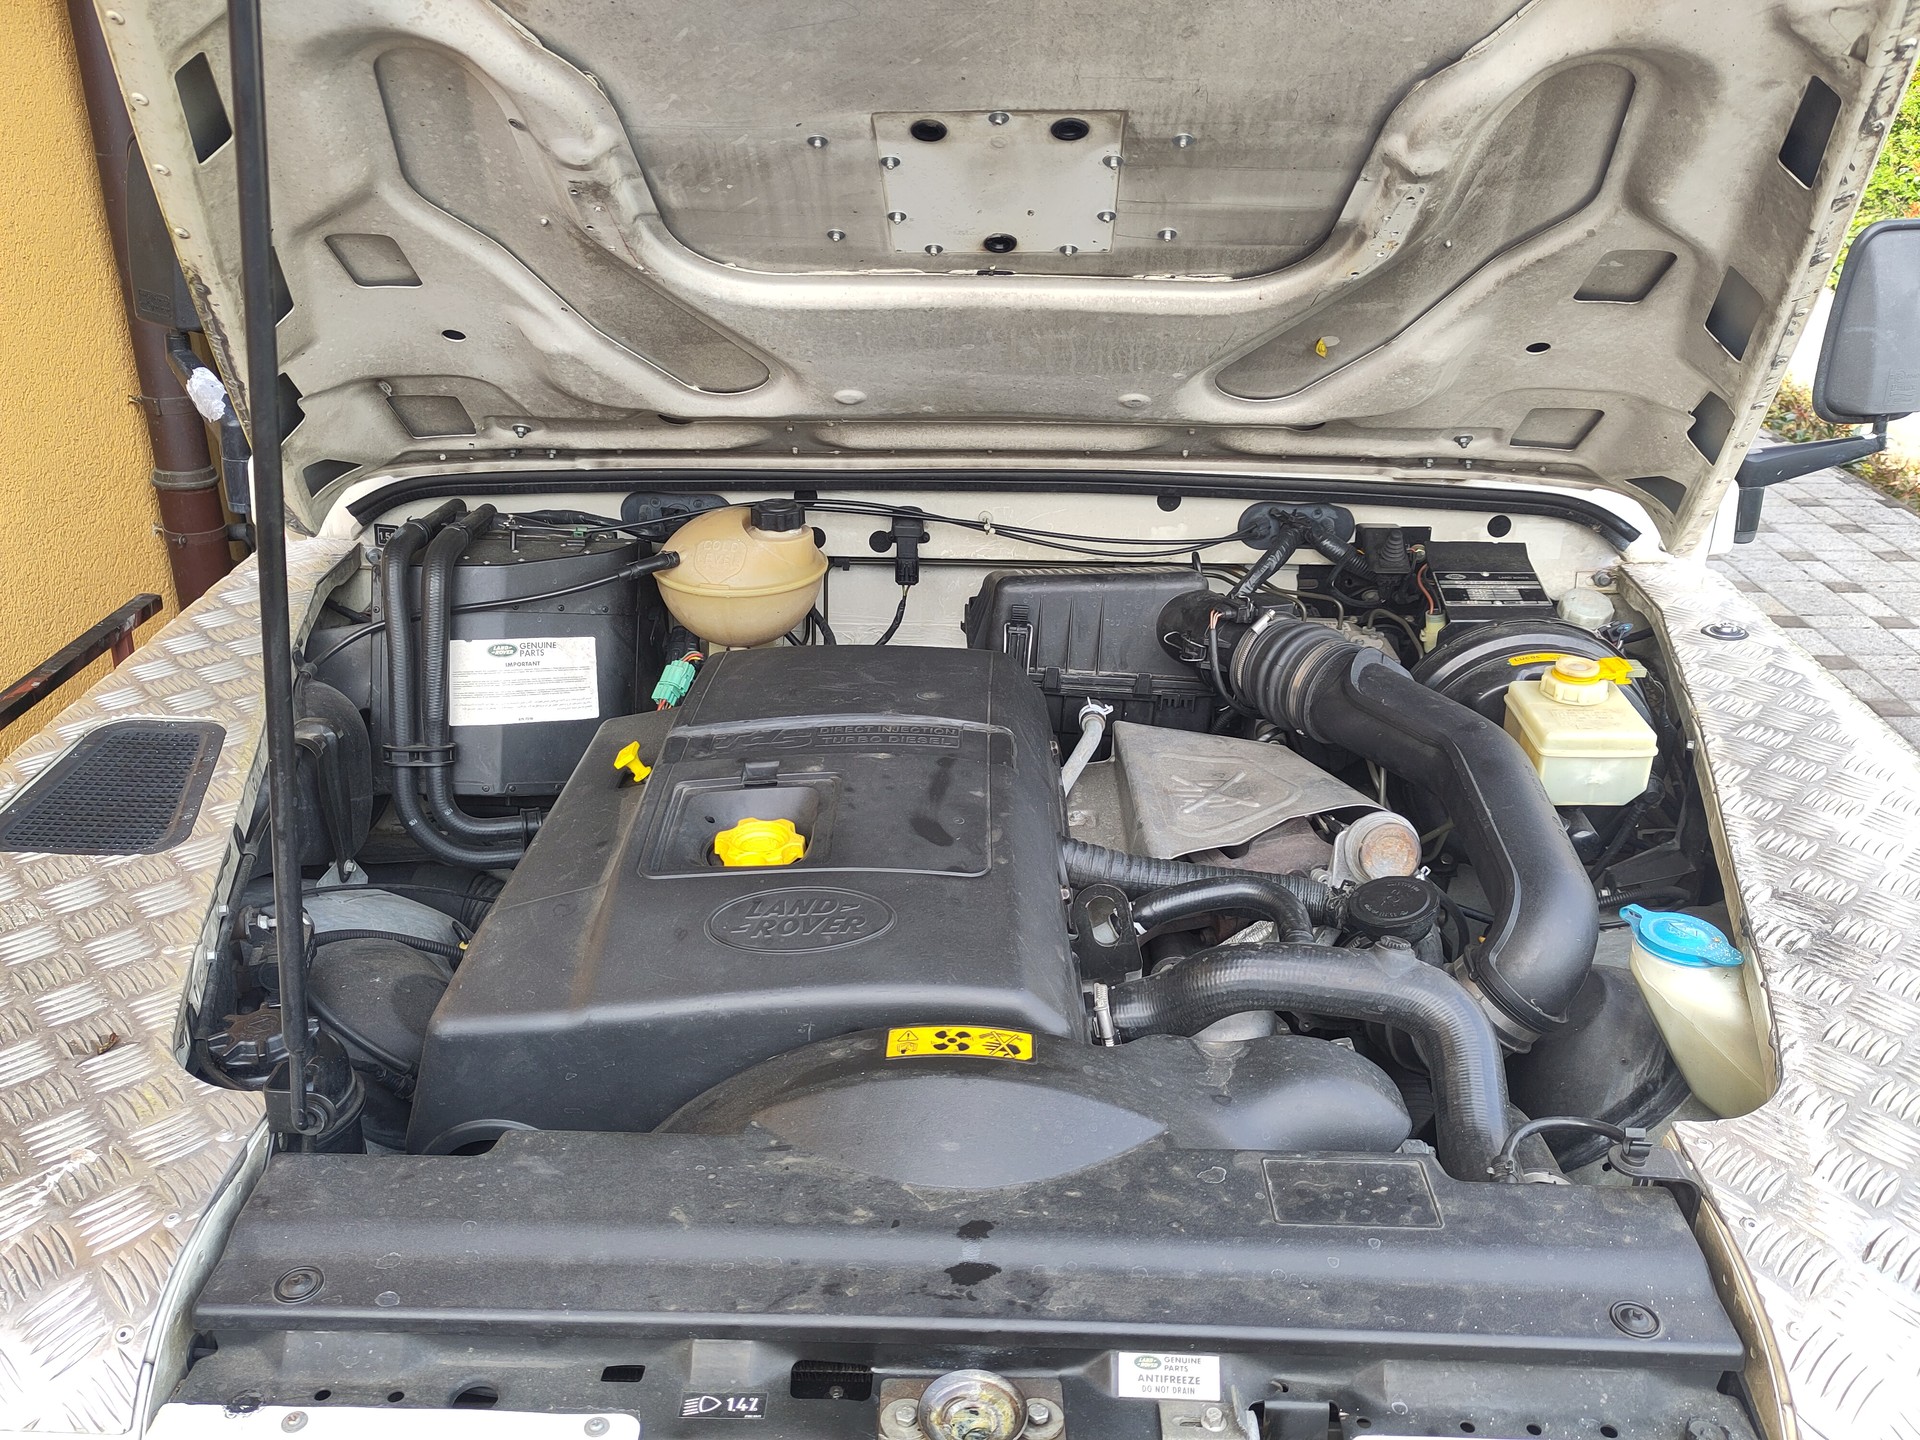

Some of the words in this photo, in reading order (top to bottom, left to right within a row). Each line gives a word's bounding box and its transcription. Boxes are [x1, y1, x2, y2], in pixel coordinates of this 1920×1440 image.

[703, 540, 739, 553] COLD
[519, 641, 557, 650] GENUINE
[519, 649, 545, 657] PARTS
[505, 660, 541, 668] IMPORTANT
[819, 725, 874, 735] DIRECT
[877, 725, 957, 736] INJECTION
[822, 735, 883, 745] TURBO
[888, 736, 952, 745] DIESEL
[744, 899, 861, 919] LAND
[734, 915, 868, 939] ROVER
[1163, 1356, 1202, 1365] GENUINE
[1163, 1364, 1189, 1373] PARTS
[1137, 1374, 1201, 1385] ANTIFREEZE
[1141, 1384, 1152, 1393] DO
[1155, 1385, 1170, 1394] NOT
[1172, 1386, 1196, 1395] DRAIN
[726, 1397, 759, 1412] 1.4%
